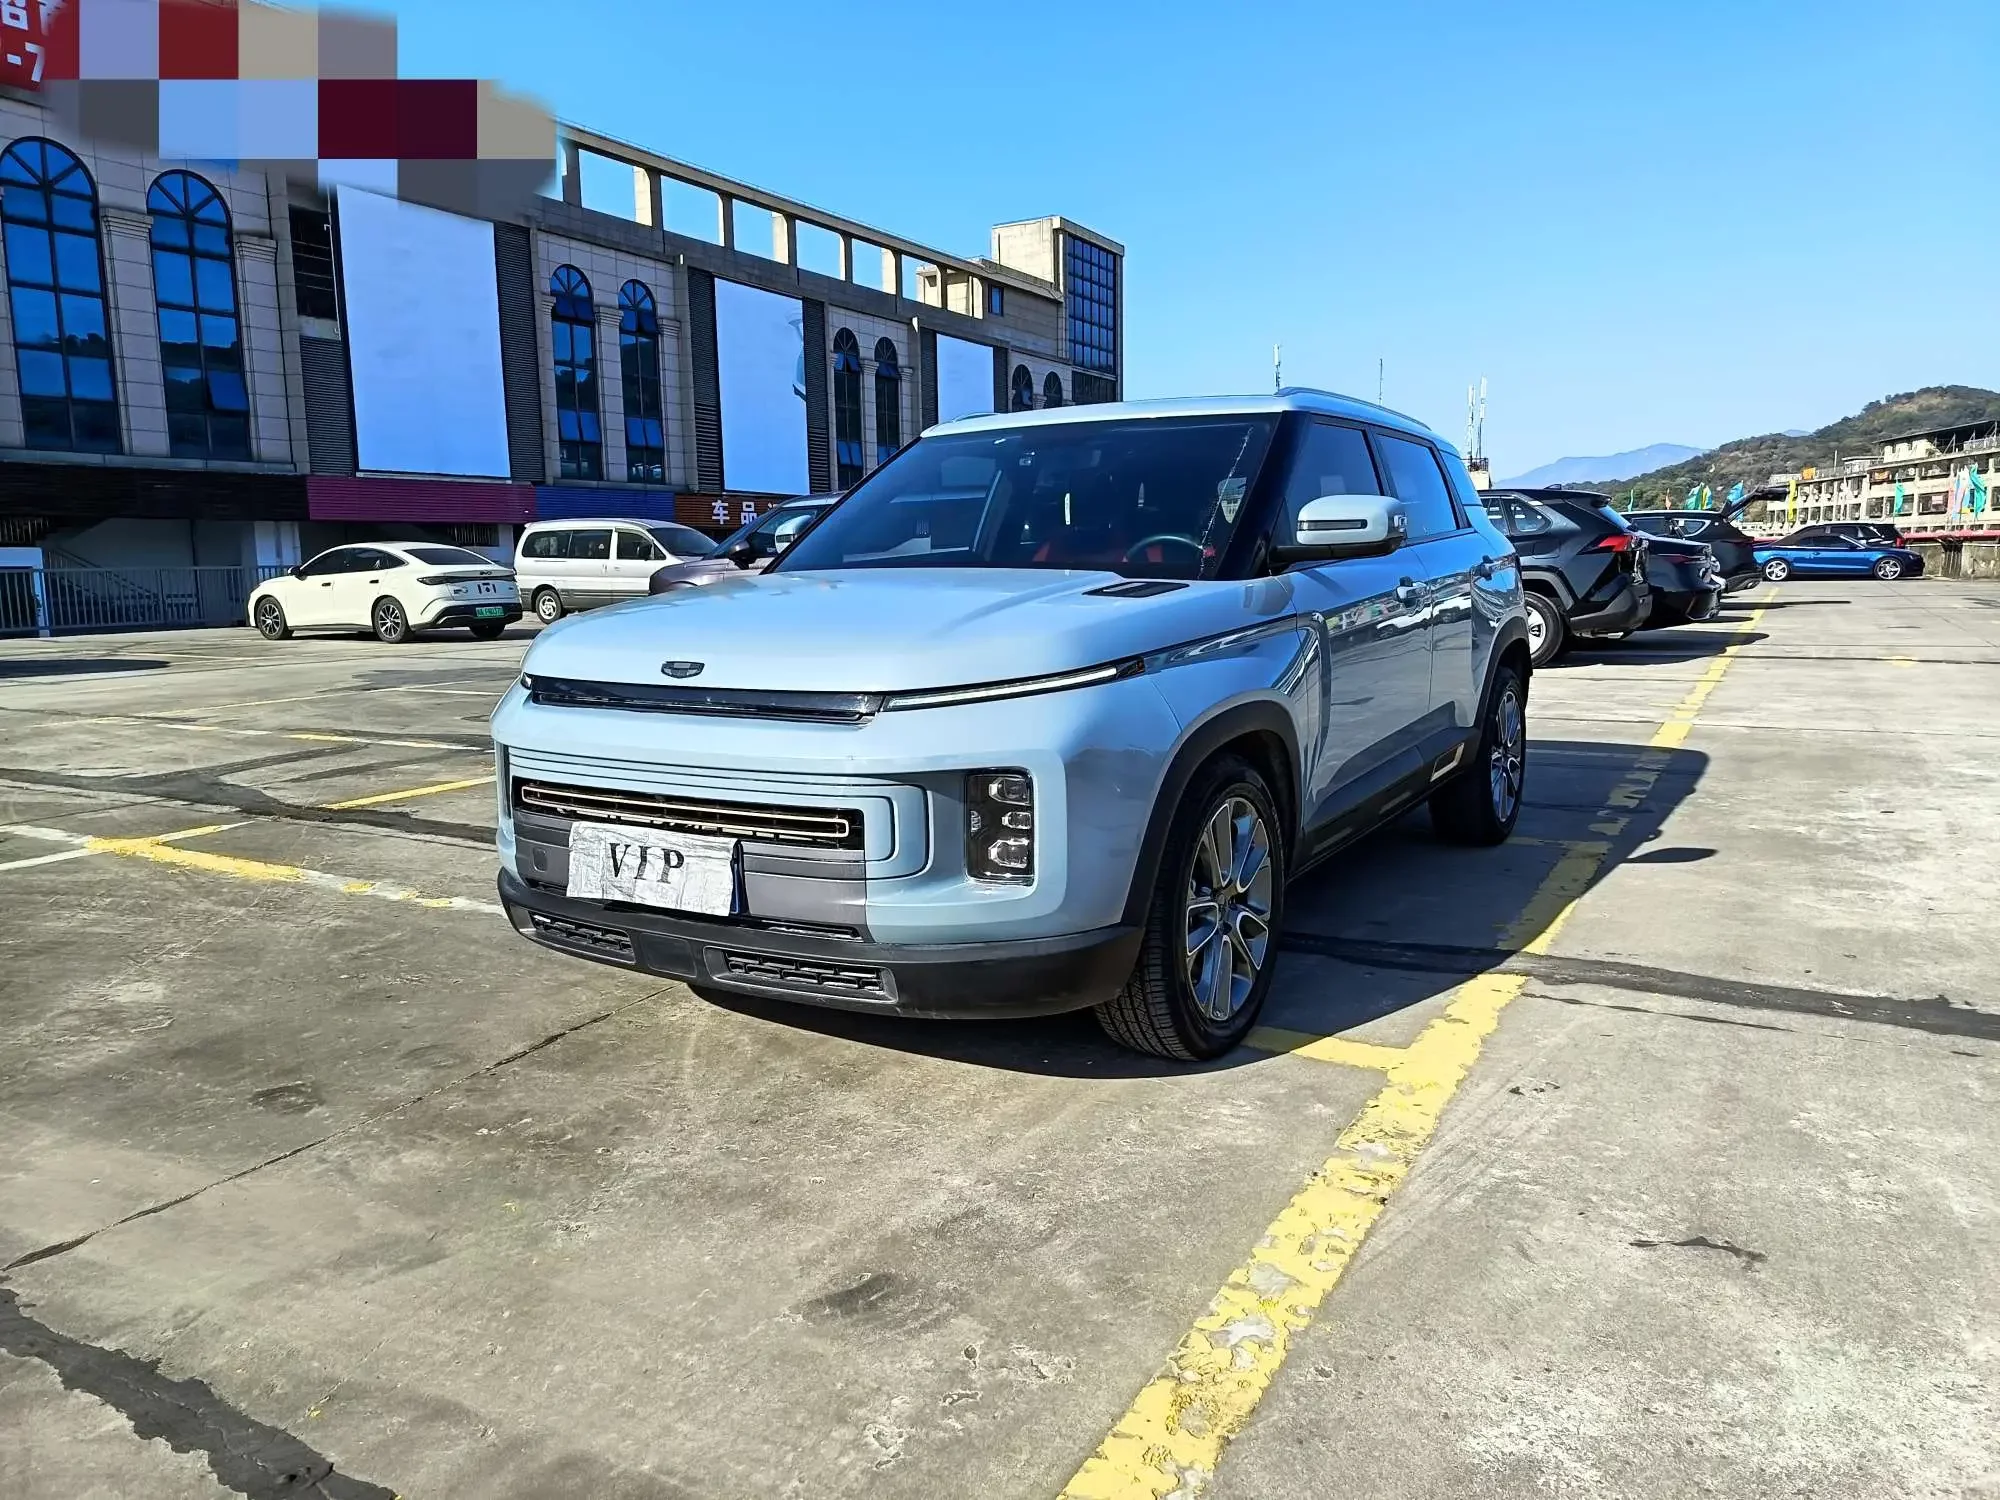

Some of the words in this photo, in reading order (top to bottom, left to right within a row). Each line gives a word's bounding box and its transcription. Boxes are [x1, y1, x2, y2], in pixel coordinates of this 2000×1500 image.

[0, 40, 45, 83] -7
[711, 499, 778, 525] 车品
[609, 842, 685, 885] VIP
